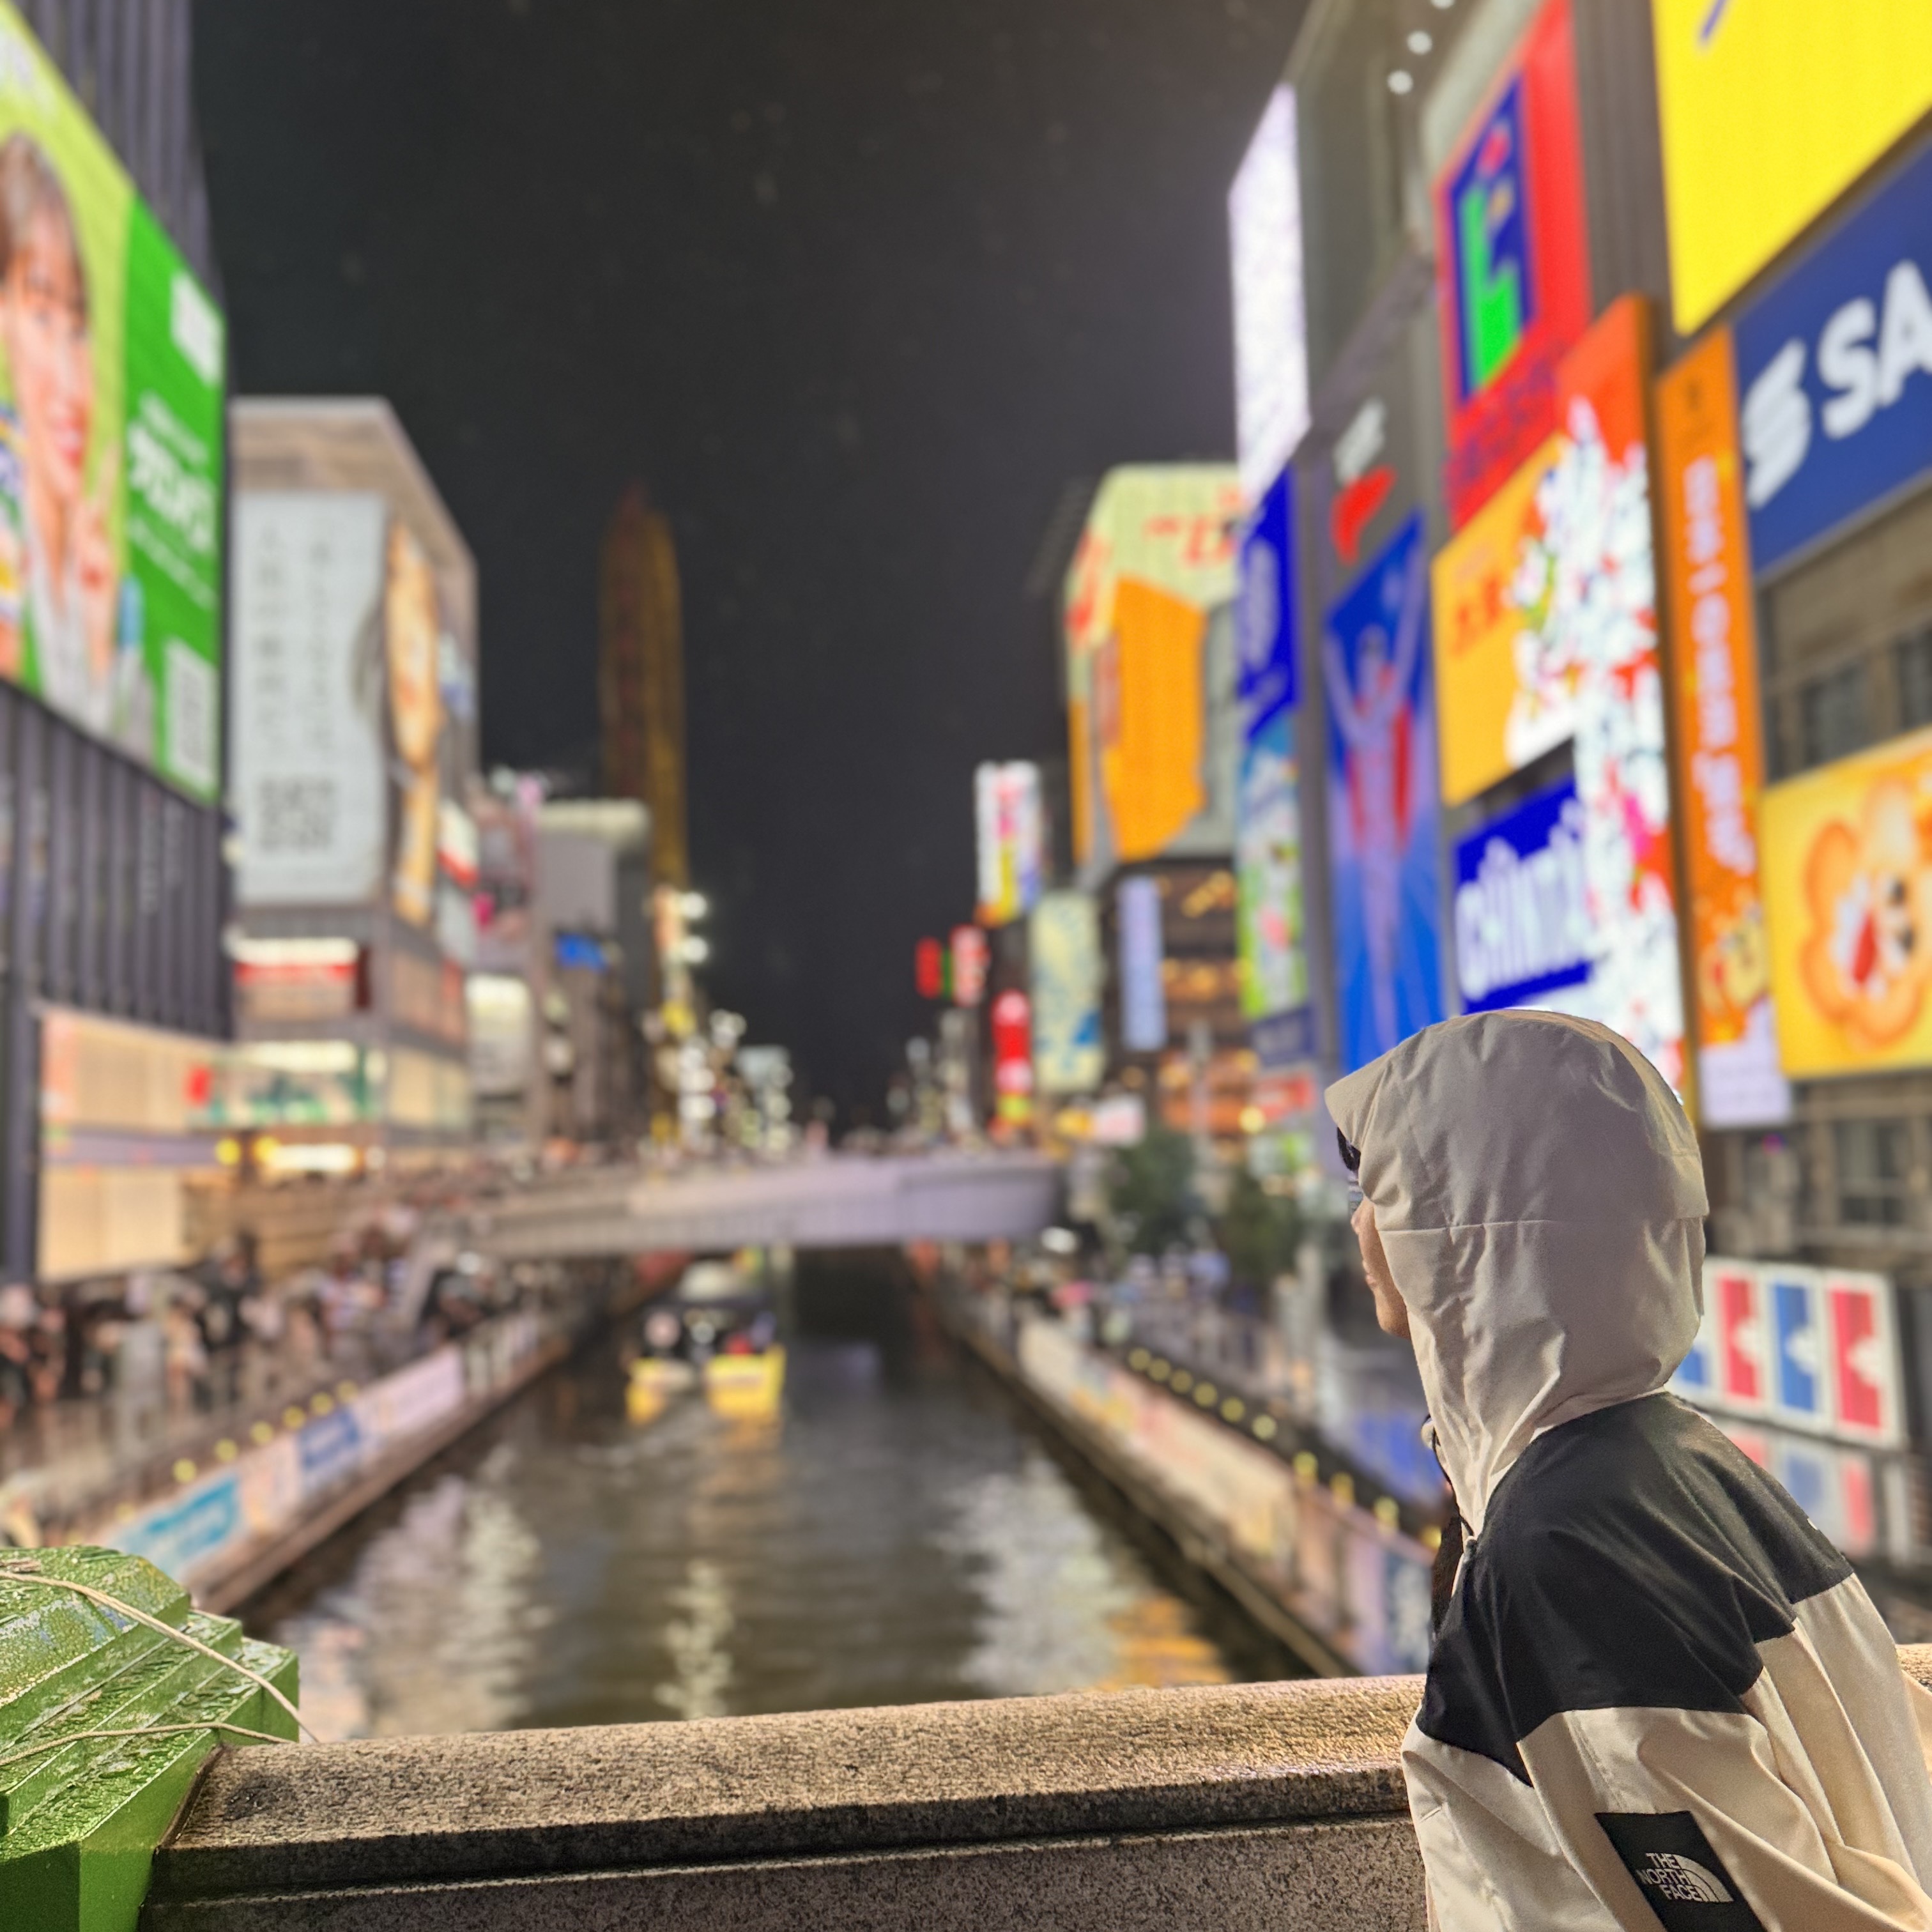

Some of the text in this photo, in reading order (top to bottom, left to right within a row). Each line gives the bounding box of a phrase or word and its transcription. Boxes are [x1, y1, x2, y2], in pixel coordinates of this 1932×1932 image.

[1646, 1853, 1682, 1869] THE
[1636, 1868, 1692, 1885] NORTH
[1659, 1884, 1704, 1901] FACE
